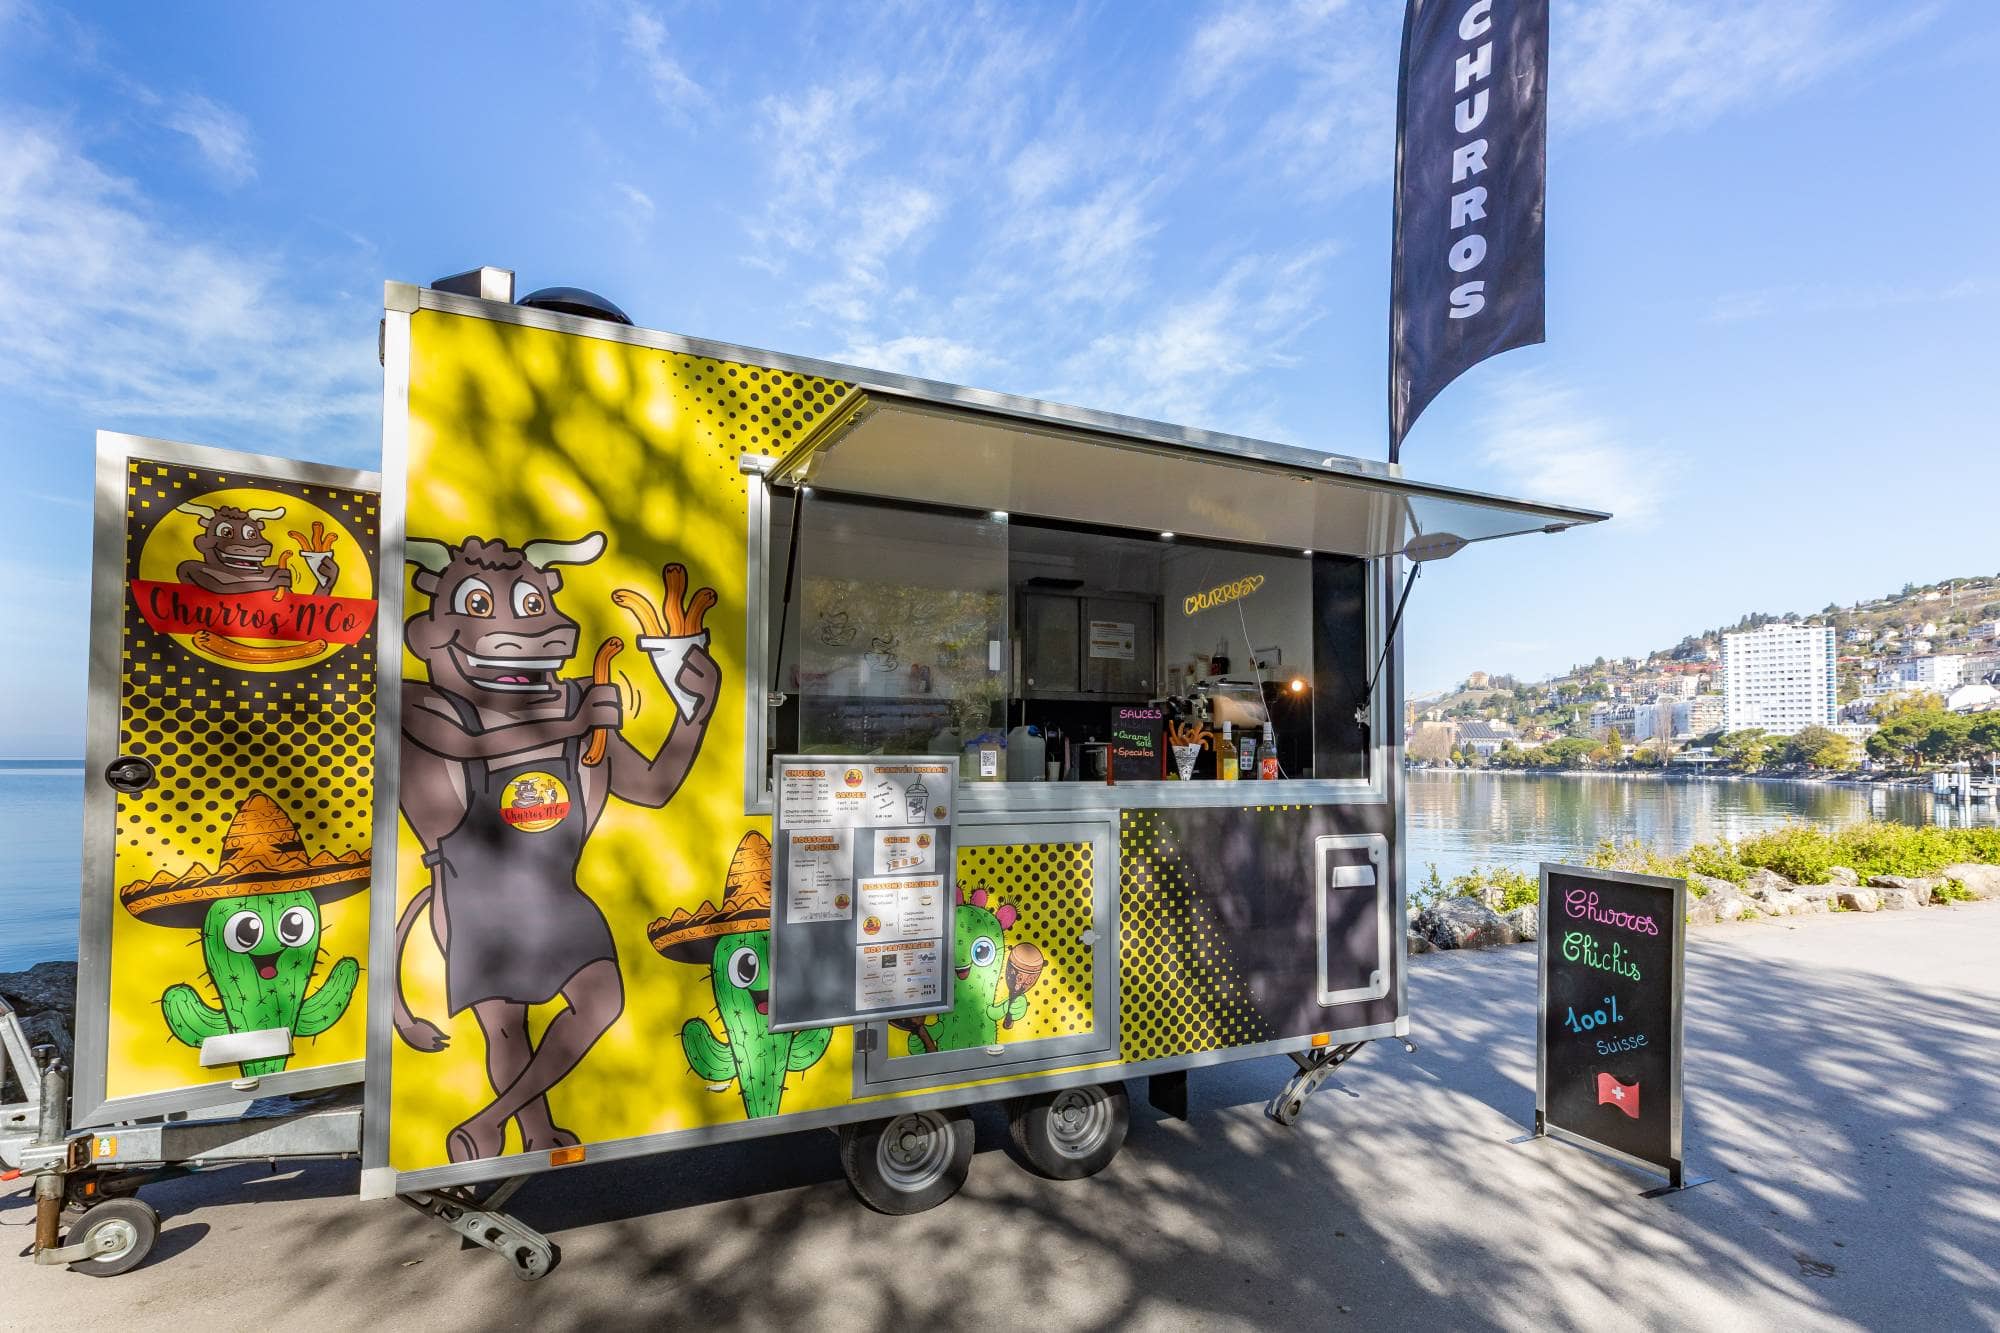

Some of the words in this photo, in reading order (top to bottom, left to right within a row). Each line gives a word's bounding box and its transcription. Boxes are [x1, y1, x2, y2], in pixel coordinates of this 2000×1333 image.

[1449, 0, 1493, 319] CHURROS
[1184, 578, 1250, 615] CHURROS
[1119, 709, 1162, 719] SAUCES
[1118, 747, 1154, 758] Speculos
[1119, 730, 1151, 741] Caramel
[785, 769, 826, 778] CHURROS
[1565, 888, 1659, 936] Churros
[1562, 931, 1641, 981] Chichis
[1564, 995, 1624, 1033] 100%
